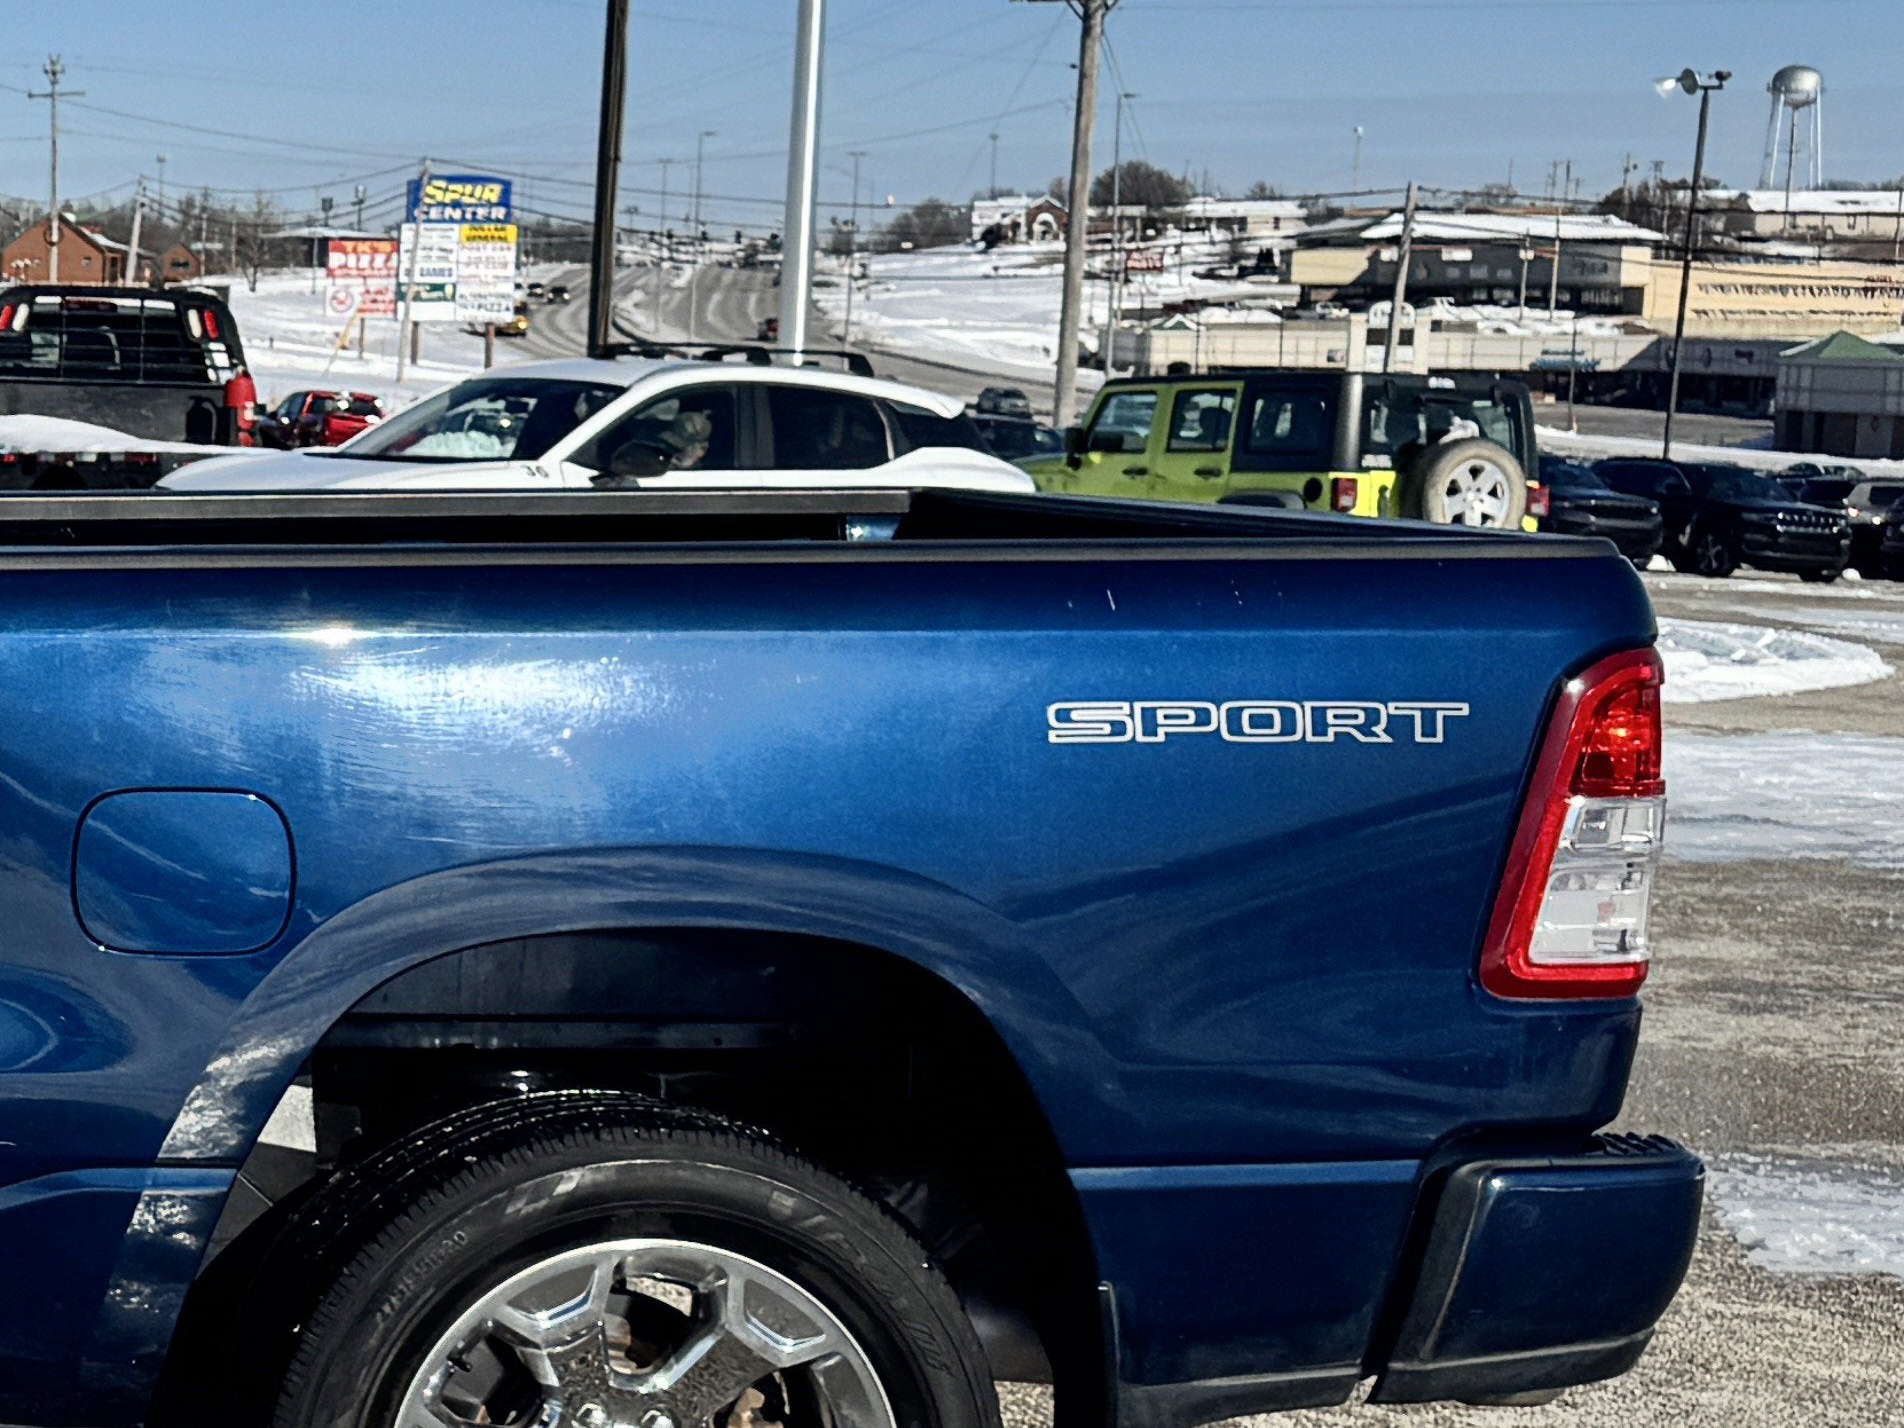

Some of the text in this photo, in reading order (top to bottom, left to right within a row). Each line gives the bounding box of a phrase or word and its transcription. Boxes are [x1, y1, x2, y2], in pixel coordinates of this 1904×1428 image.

[423, 179, 503, 204] SPUR
[413, 206, 507, 221] CENTER
[1047, 700, 1470, 744] SPORT
